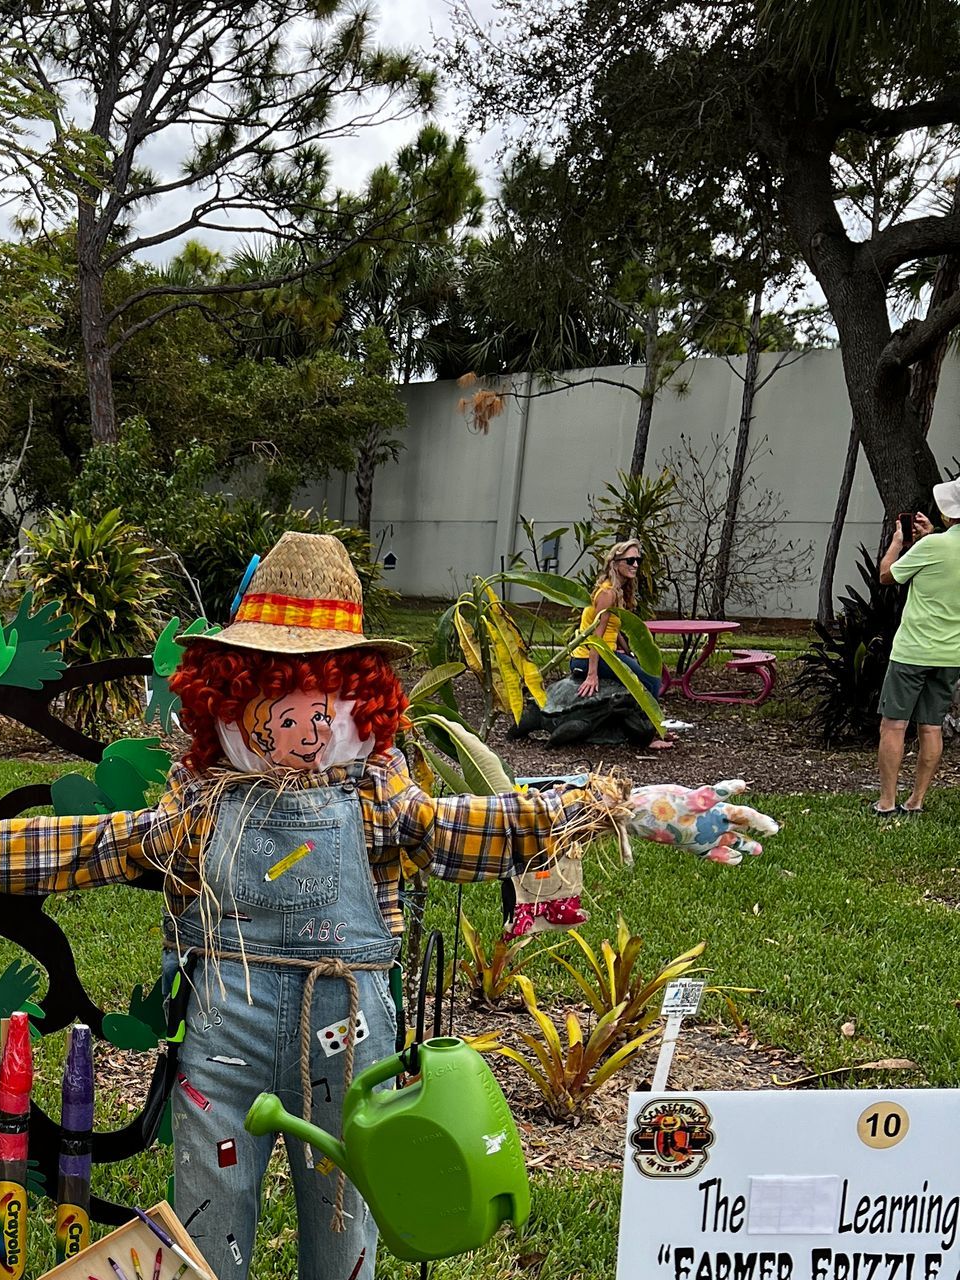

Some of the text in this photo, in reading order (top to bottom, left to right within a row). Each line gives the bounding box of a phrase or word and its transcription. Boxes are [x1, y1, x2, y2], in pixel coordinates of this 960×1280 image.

[251, 837, 276, 857] 30
[643, 1103, 705, 1122] SCARECROWS
[865, 1113, 901, 1139] 10
[646, 1158, 694, 1173] IN THE PARK
[699, 1178, 960, 1250] The Learning
[5, 1200, 21, 1265] Crayola
